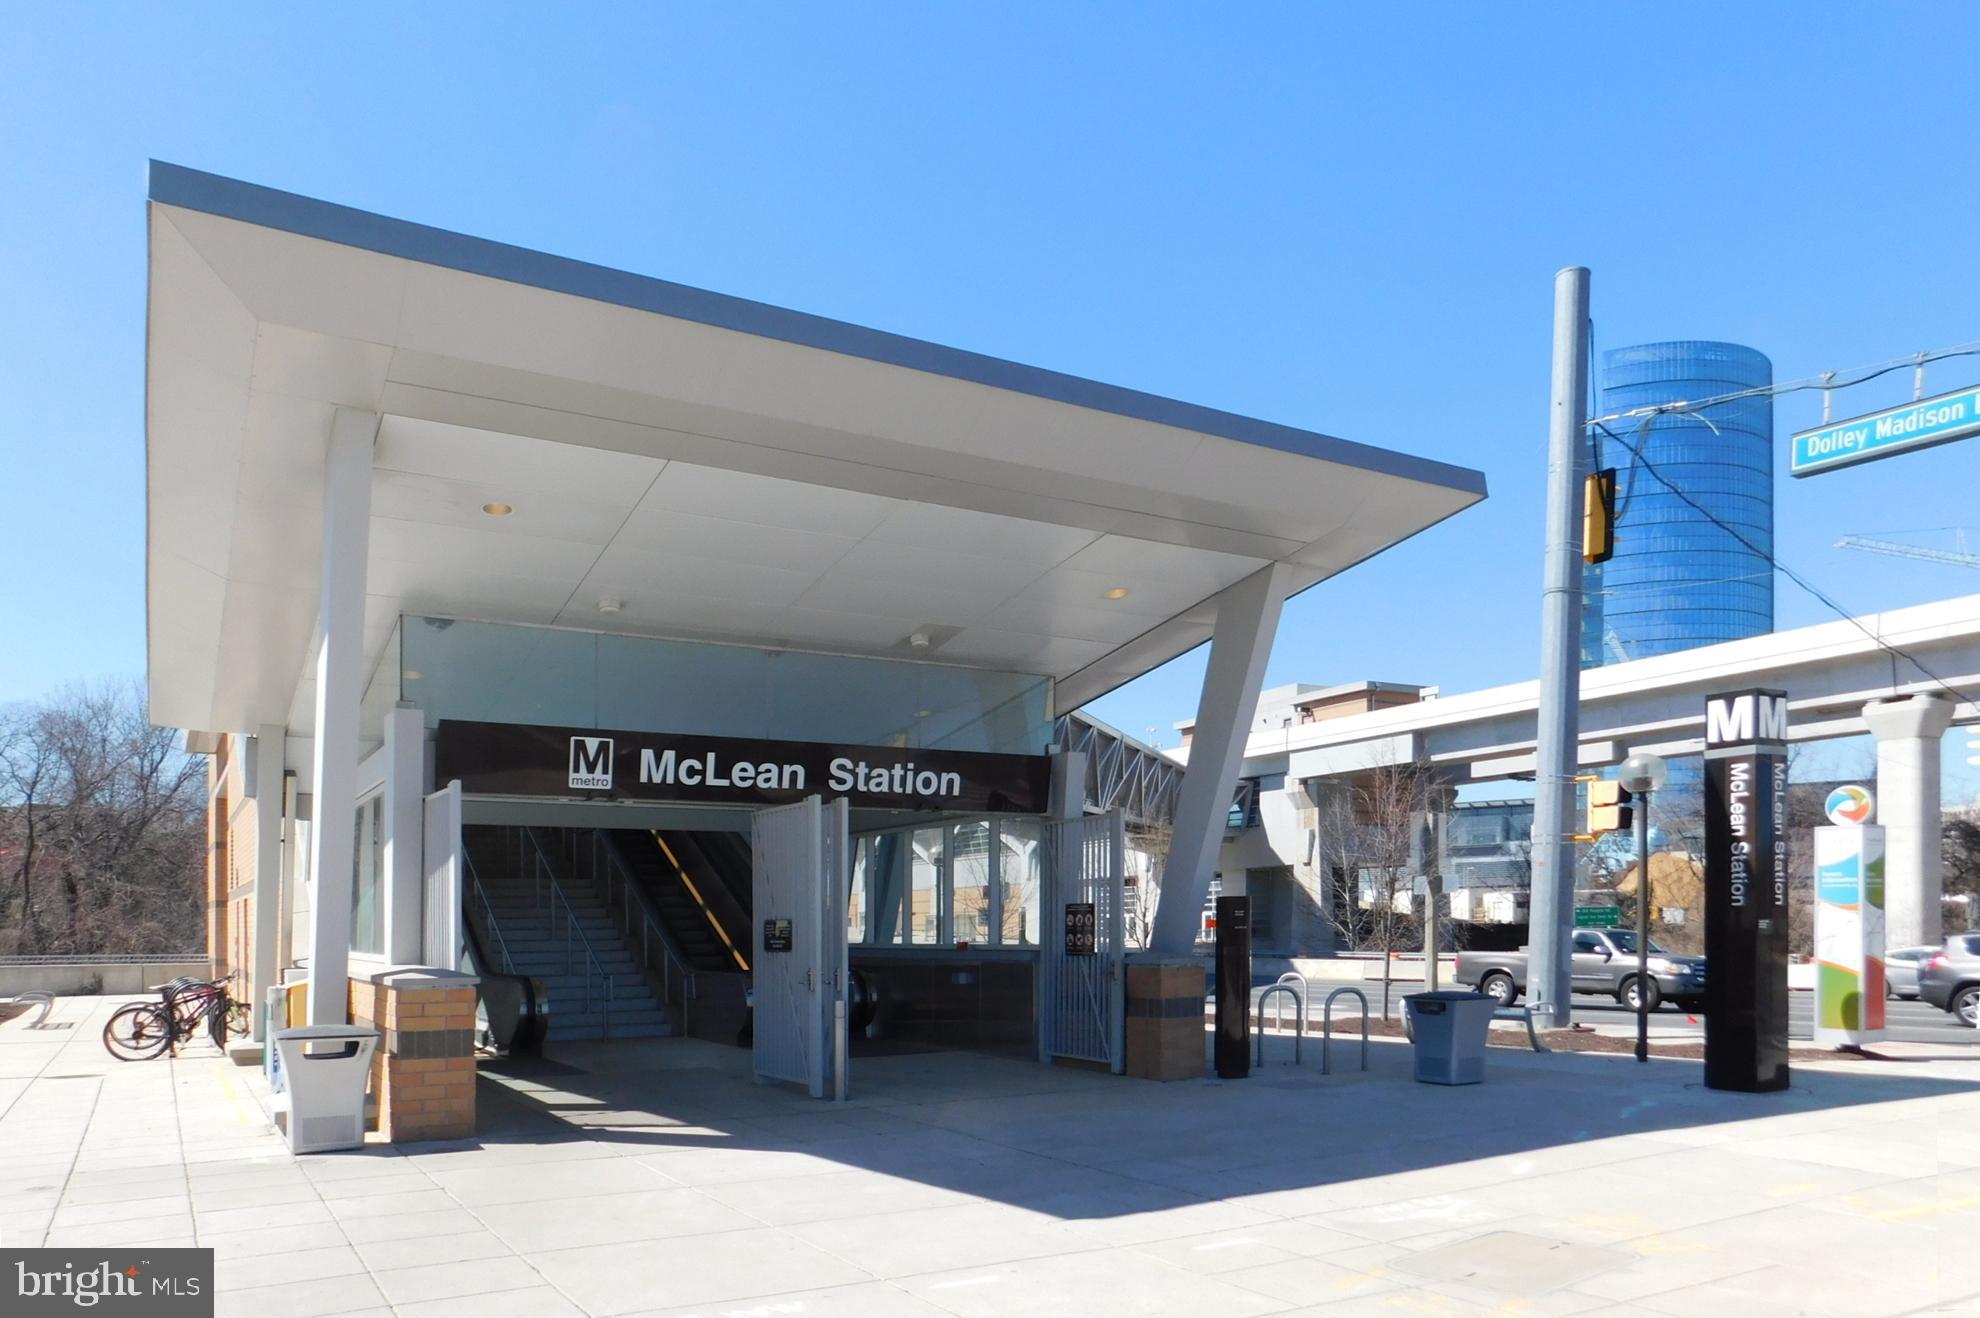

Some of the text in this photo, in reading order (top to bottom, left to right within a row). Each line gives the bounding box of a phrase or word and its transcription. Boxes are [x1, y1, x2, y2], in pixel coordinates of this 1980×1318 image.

[1807, 427, 1868, 457] Dolley
[1875, 402, 1965, 440] Madison
[1706, 695, 1753, 743] M
[1759, 695, 1787, 741] M
[572, 738, 610, 776] M
[639, 748, 961, 797] McLean Station
[571, 775, 610, 788] metro
[1729, 762, 1750, 907] McLean Station
[1774, 762, 1786, 906] McLean Station
